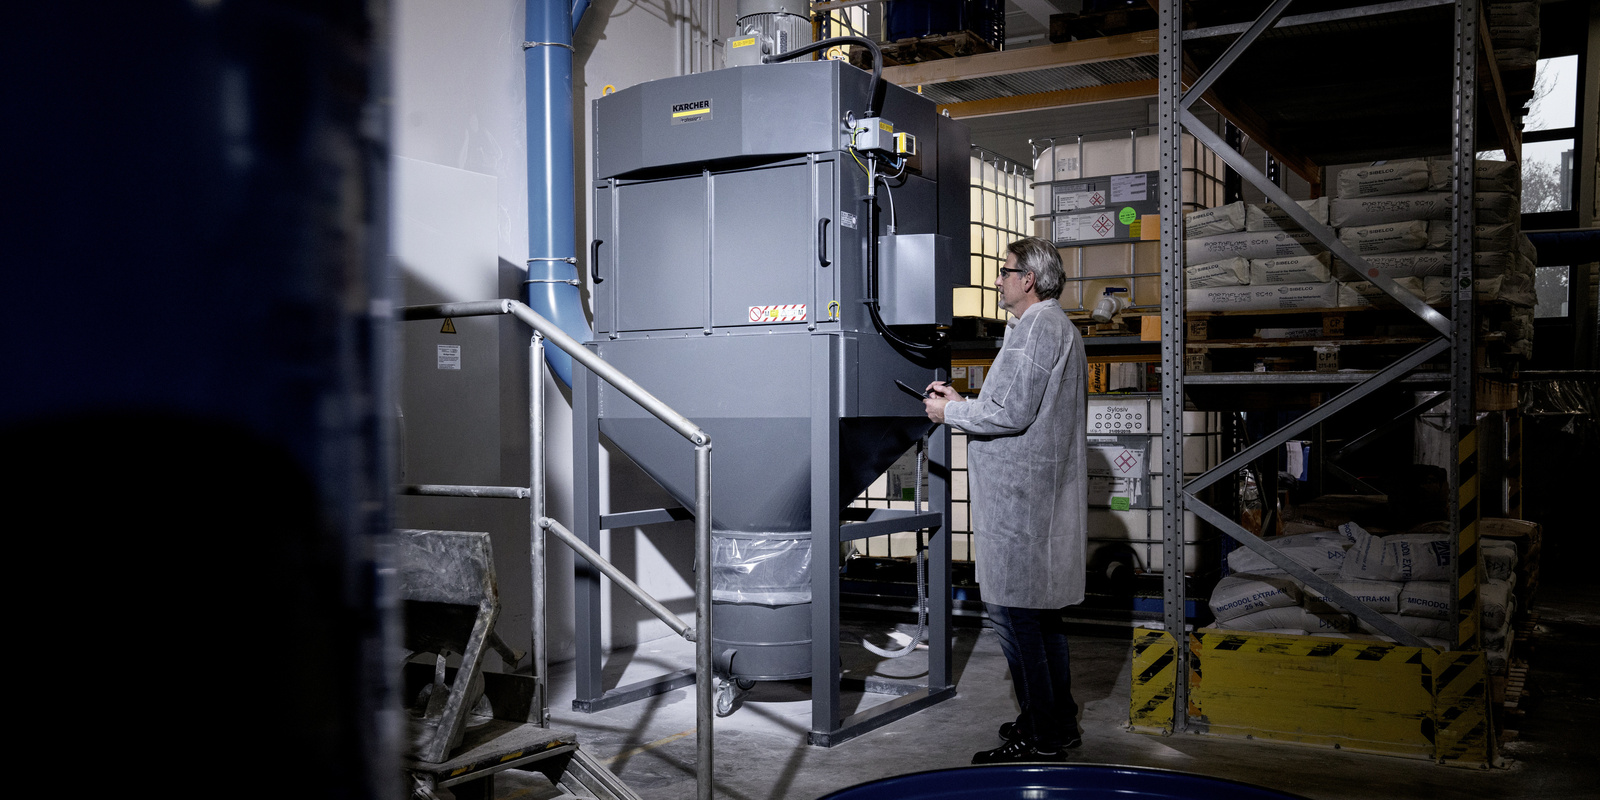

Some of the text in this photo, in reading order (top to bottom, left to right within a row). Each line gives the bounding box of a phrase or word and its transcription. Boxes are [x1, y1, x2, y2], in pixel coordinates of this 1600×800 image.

[672, 100, 710, 112] KÄRCHER
[1193, 211, 1214, 220] SIBELCO
[1197, 264, 1219, 272] SIBELCO
[1319, 353, 1337, 361] CP1
[1106, 406, 1129, 414] Sylosiv
[1216, 587, 1288, 613] MICRODOL EXTRA-KN
